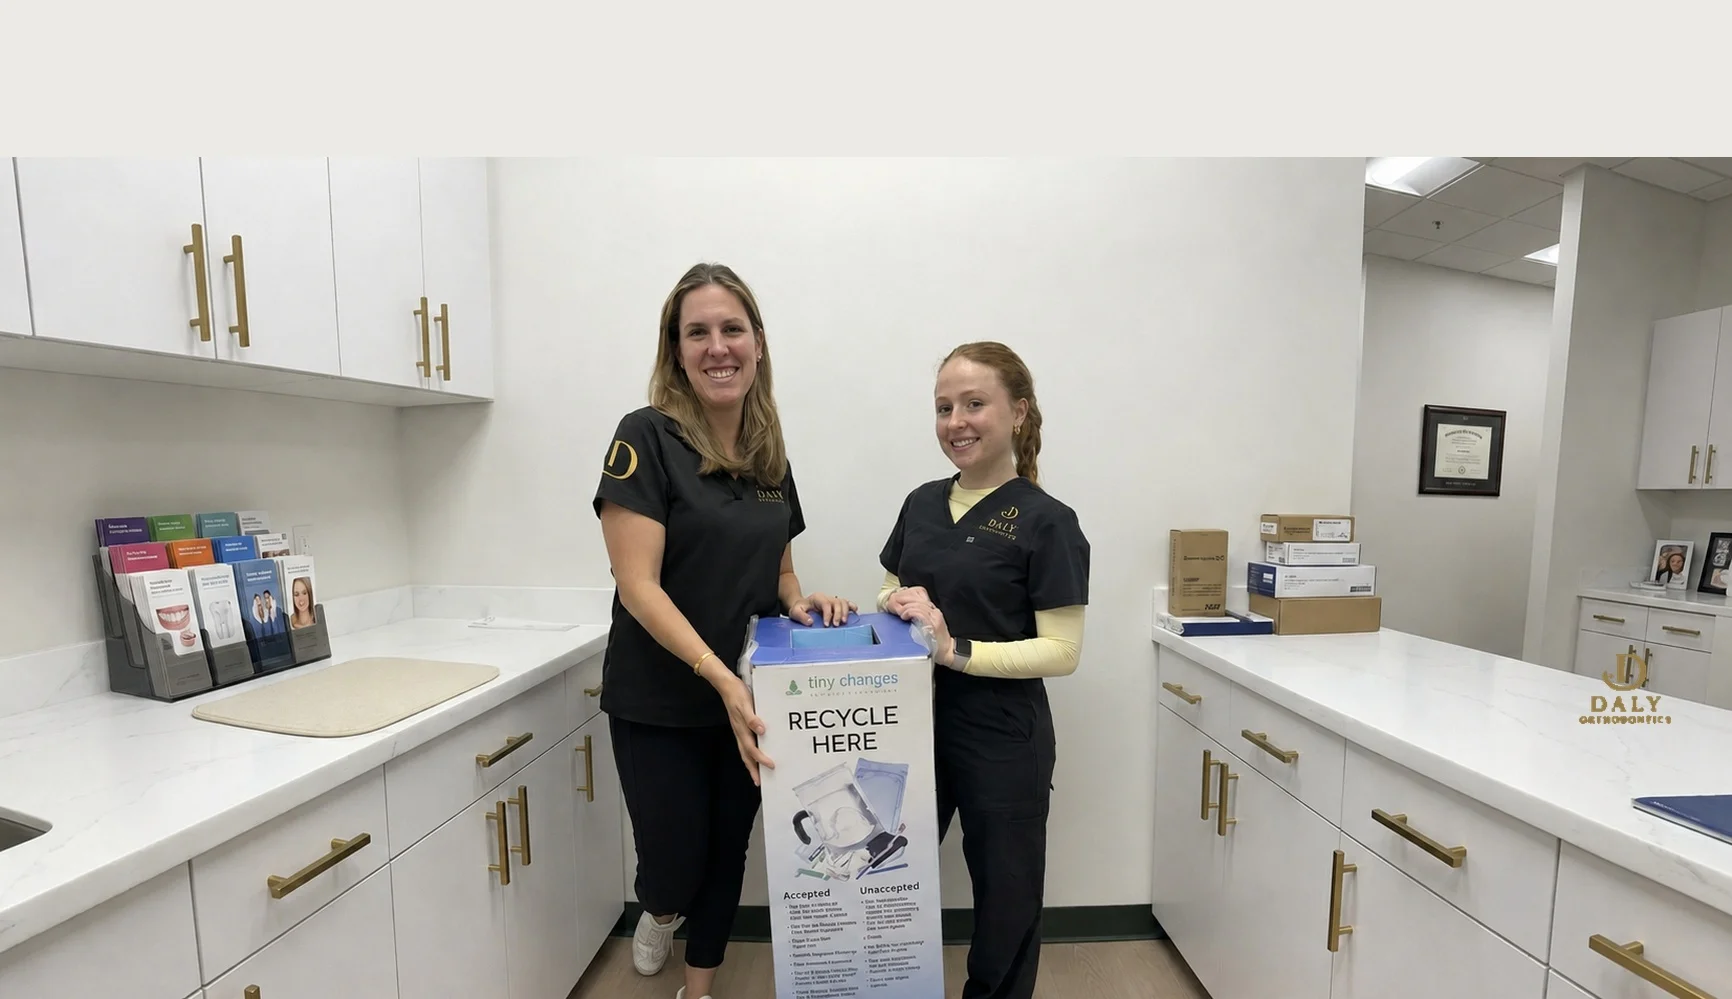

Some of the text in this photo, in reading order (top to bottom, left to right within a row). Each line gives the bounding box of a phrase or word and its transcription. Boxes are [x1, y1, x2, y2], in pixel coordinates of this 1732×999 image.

[988, 519, 1017, 533] DALY
[808, 673, 898, 691] tiny changes
[788, 705, 899, 731] RECYCLE
[812, 732, 878, 754] HERE
[783, 888, 831, 900] Accepted
[860, 882, 920, 895] Unaccepted
